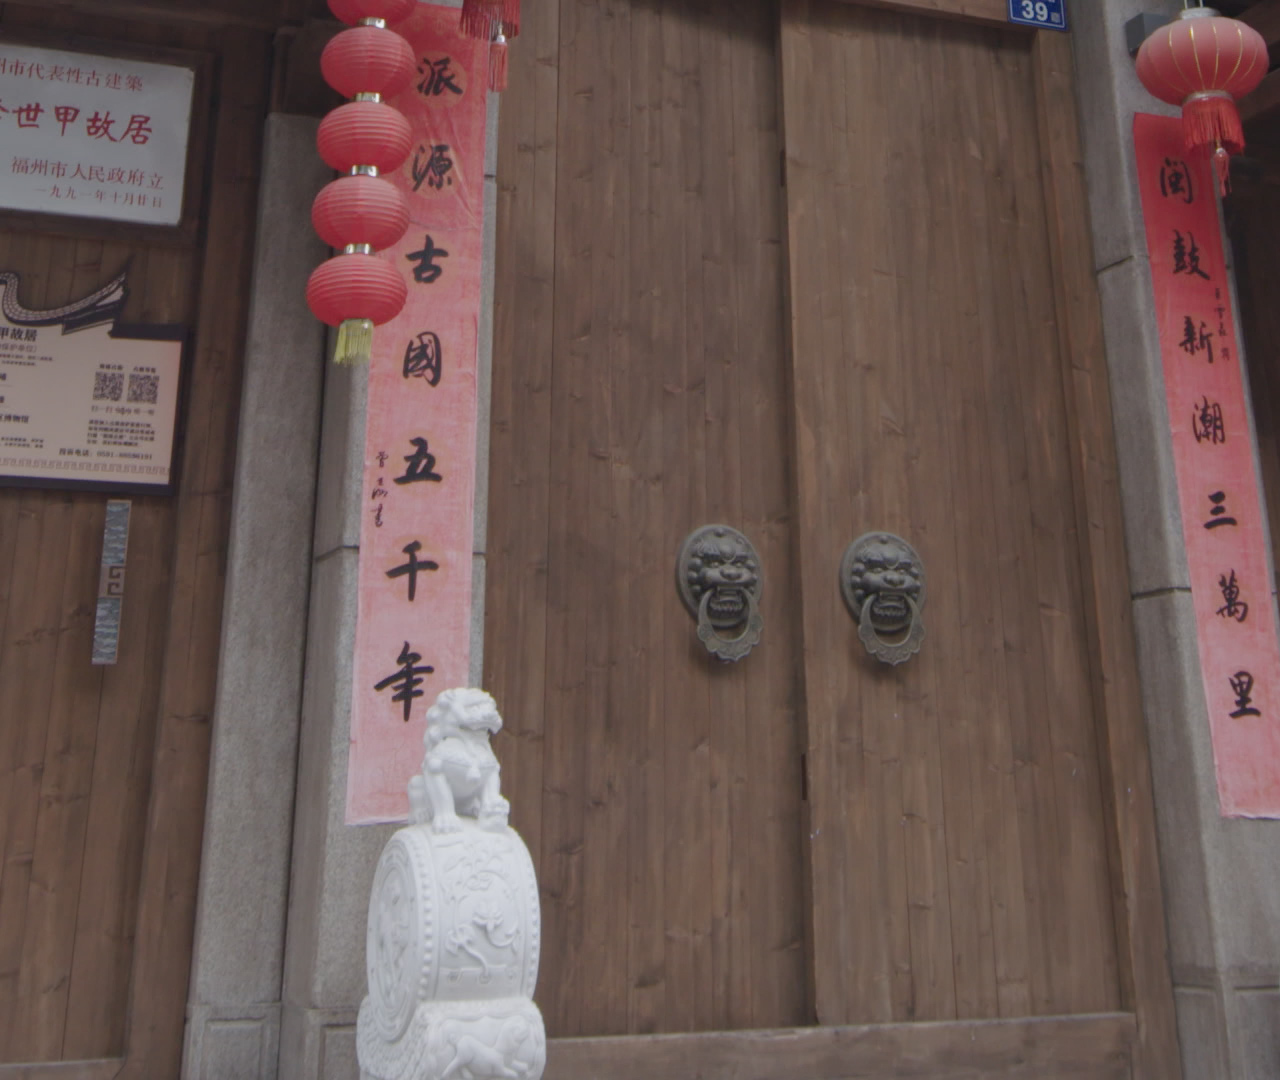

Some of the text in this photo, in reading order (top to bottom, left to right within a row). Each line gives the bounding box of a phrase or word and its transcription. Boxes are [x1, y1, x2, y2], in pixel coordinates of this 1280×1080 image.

[11, 156, 164, 190] 福州市人民政府立
